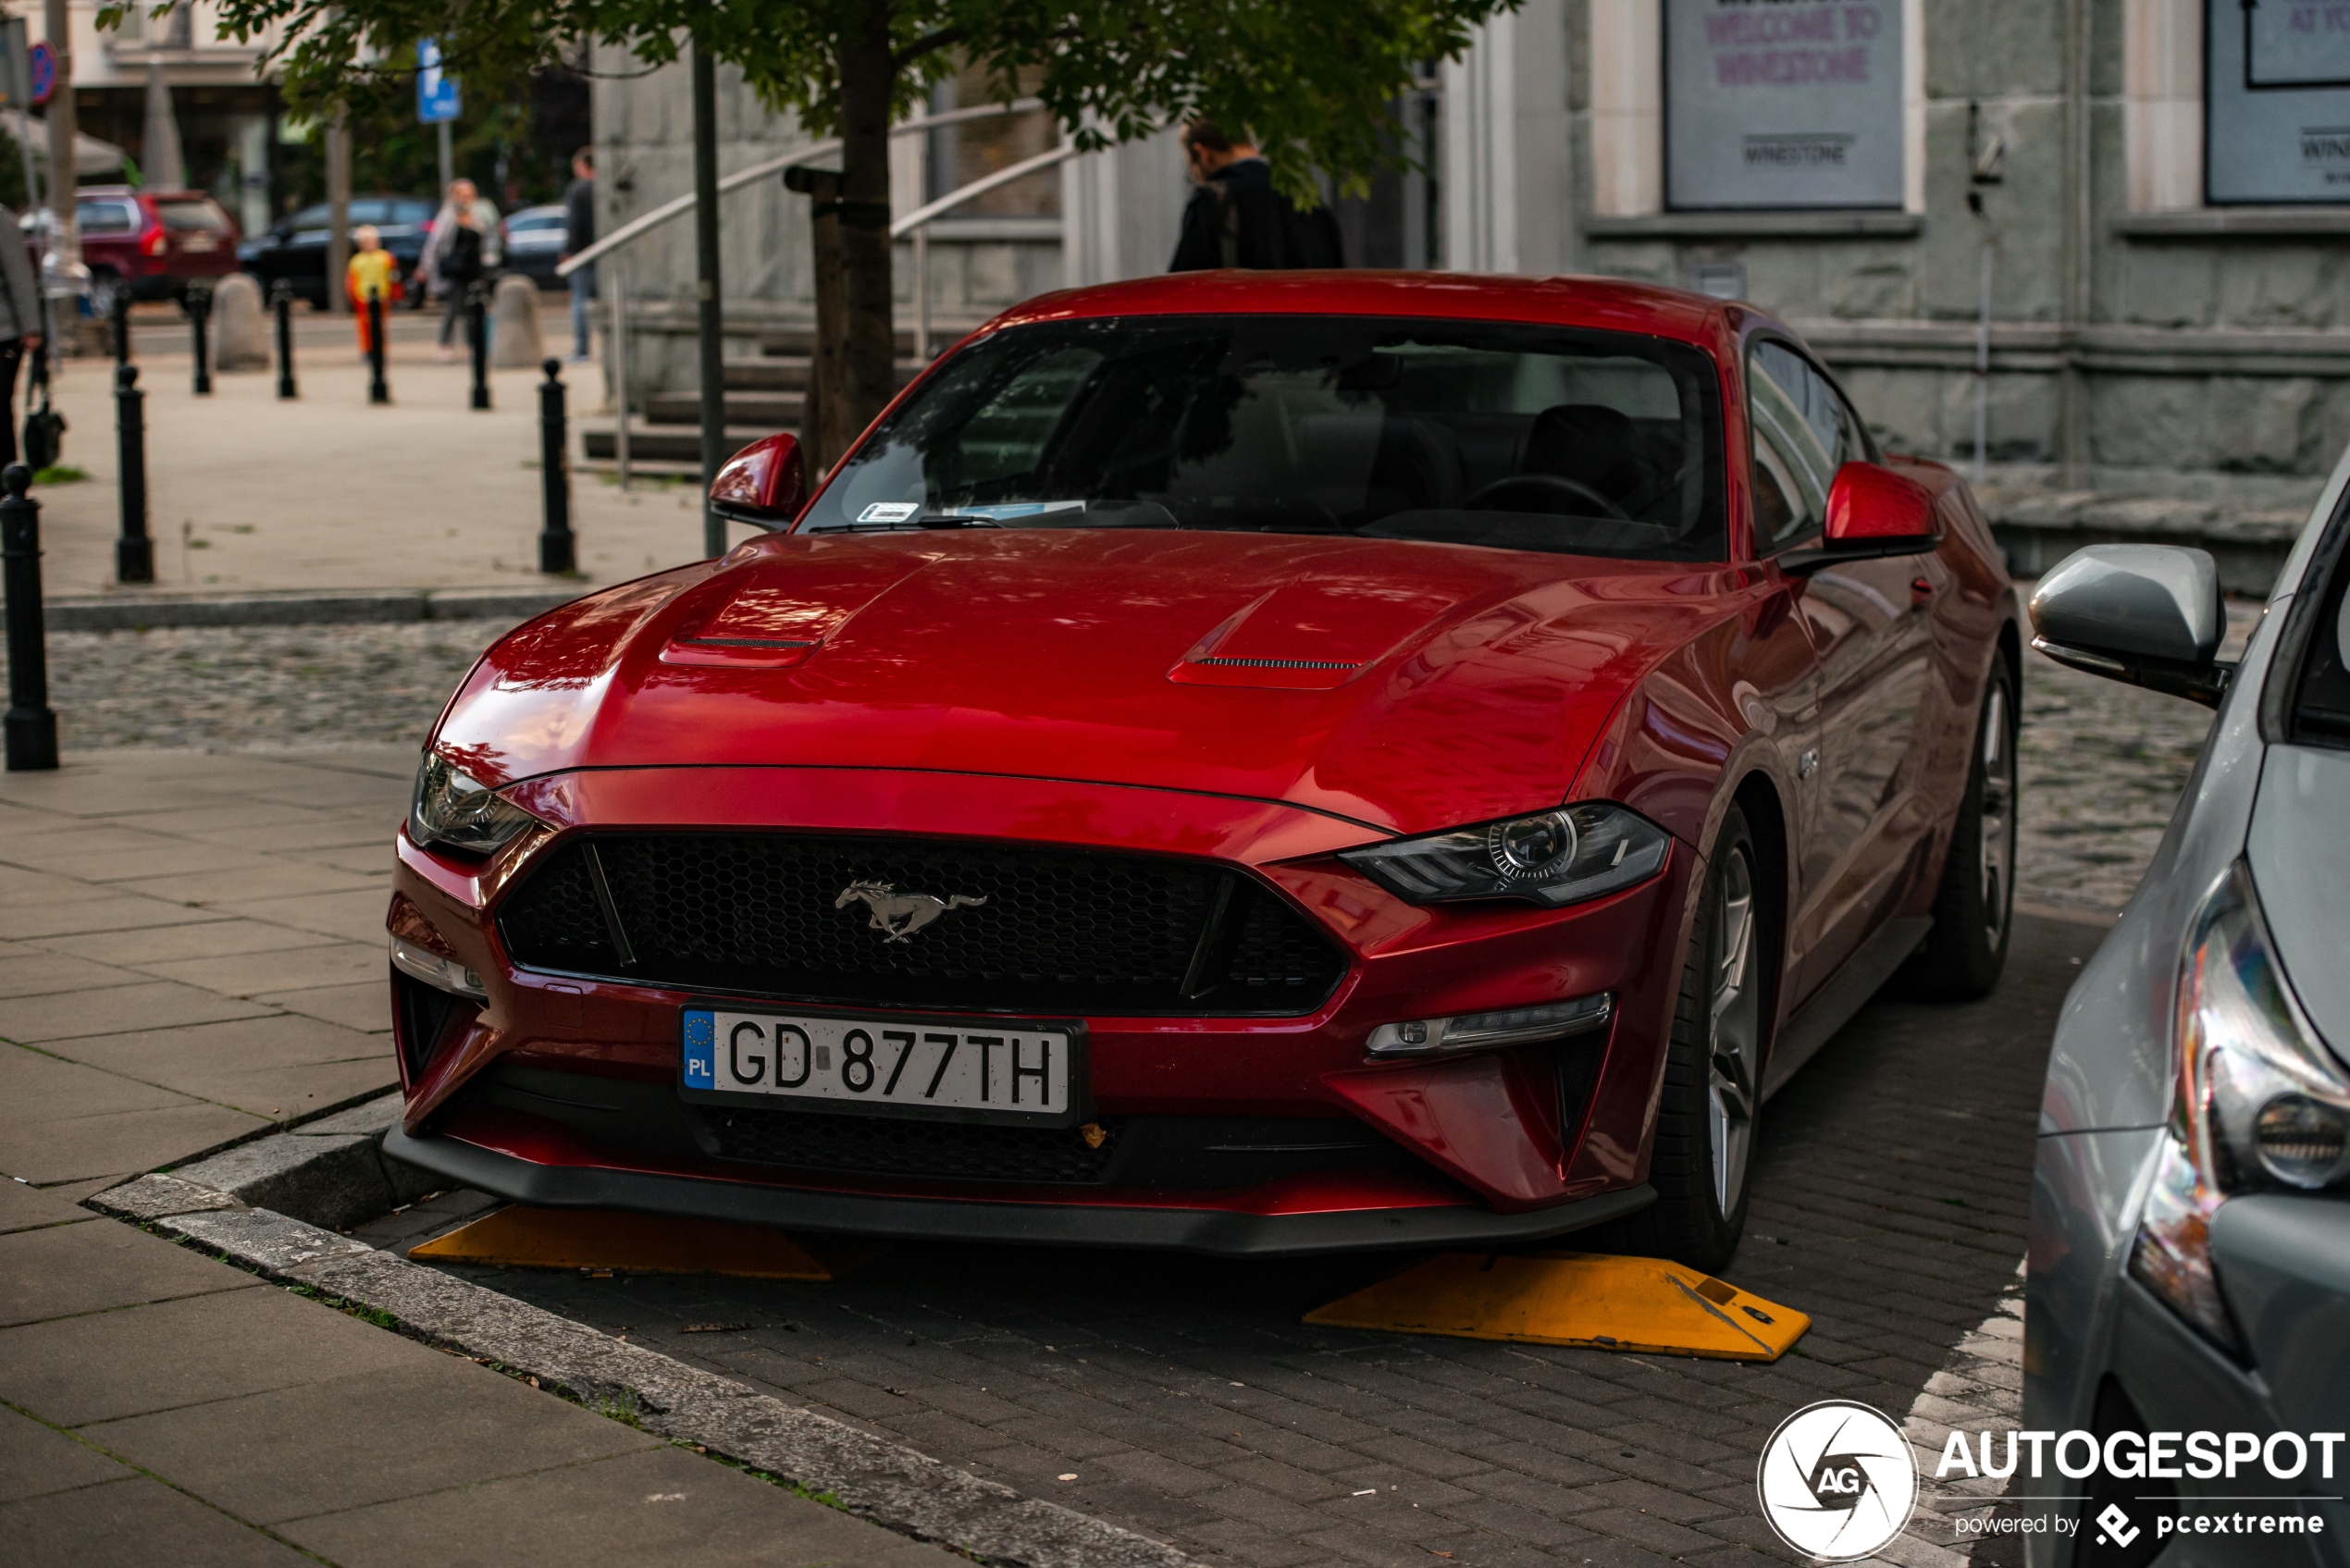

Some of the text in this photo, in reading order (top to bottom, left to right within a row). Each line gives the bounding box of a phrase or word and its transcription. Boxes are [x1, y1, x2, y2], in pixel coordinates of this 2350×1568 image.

[1705, 5, 1882, 44] WELCOME TO
[1715, 45, 1869, 84] WINESTONE
[1743, 145, 1847, 166] WINESTONE
[688, 1058, 711, 1077] PL
[729, 1020, 1051, 1106] GD 877TH
